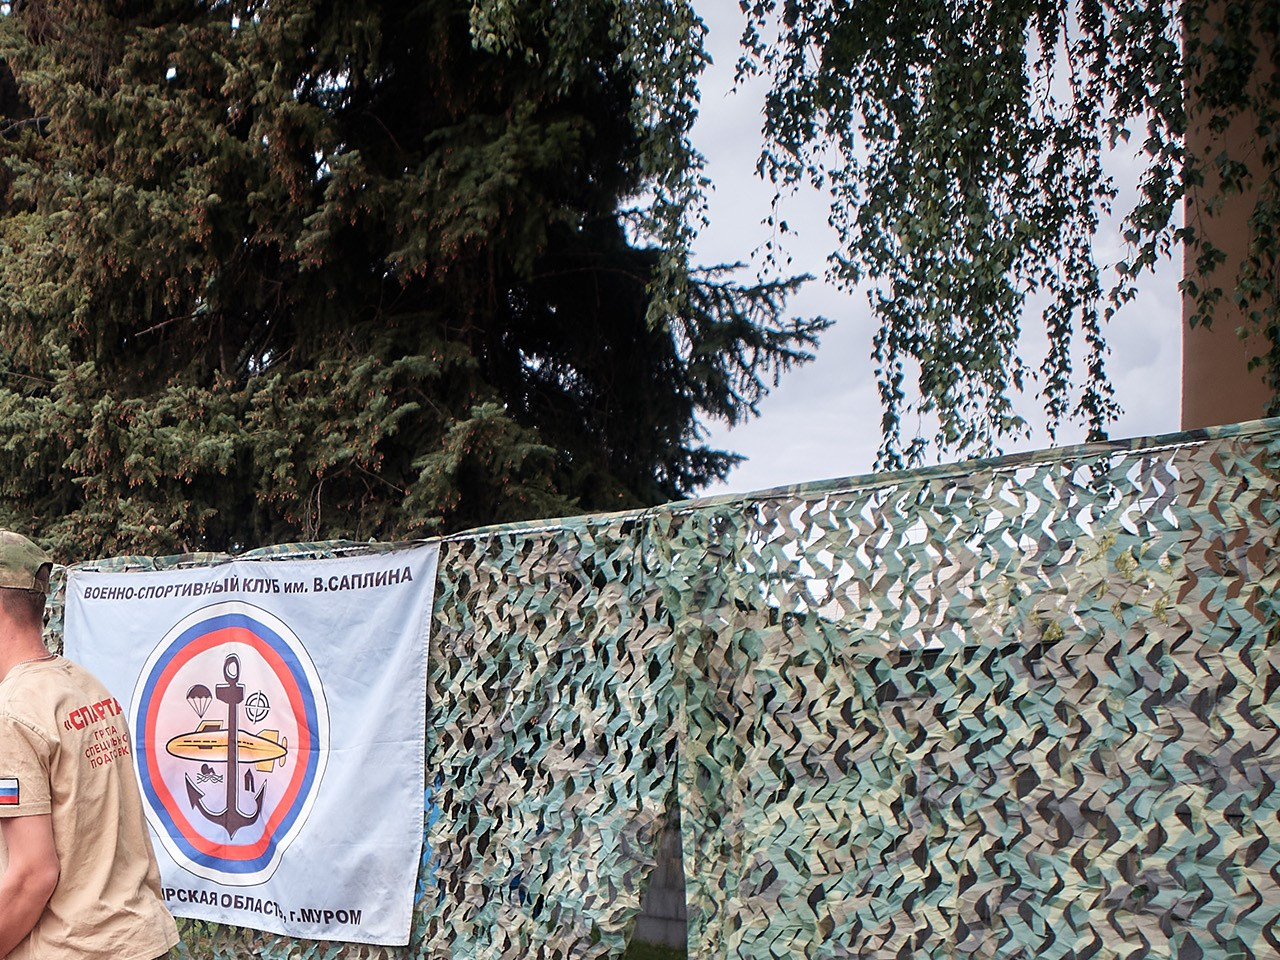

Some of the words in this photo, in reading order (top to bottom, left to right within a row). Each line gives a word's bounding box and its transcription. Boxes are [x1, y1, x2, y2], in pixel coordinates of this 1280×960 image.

[84, 574, 240, 600] ВОЕННО-СПОРТИВНЫЙ
[242, 578, 280, 594] КЛУБ
[284, 581, 308, 594] им.
[313, 566, 413, 593] В.САПЛИНА
[221, 893, 287, 924] ОБЛАСТЬ,
[289, 908, 362, 926] г.МУРОМ
